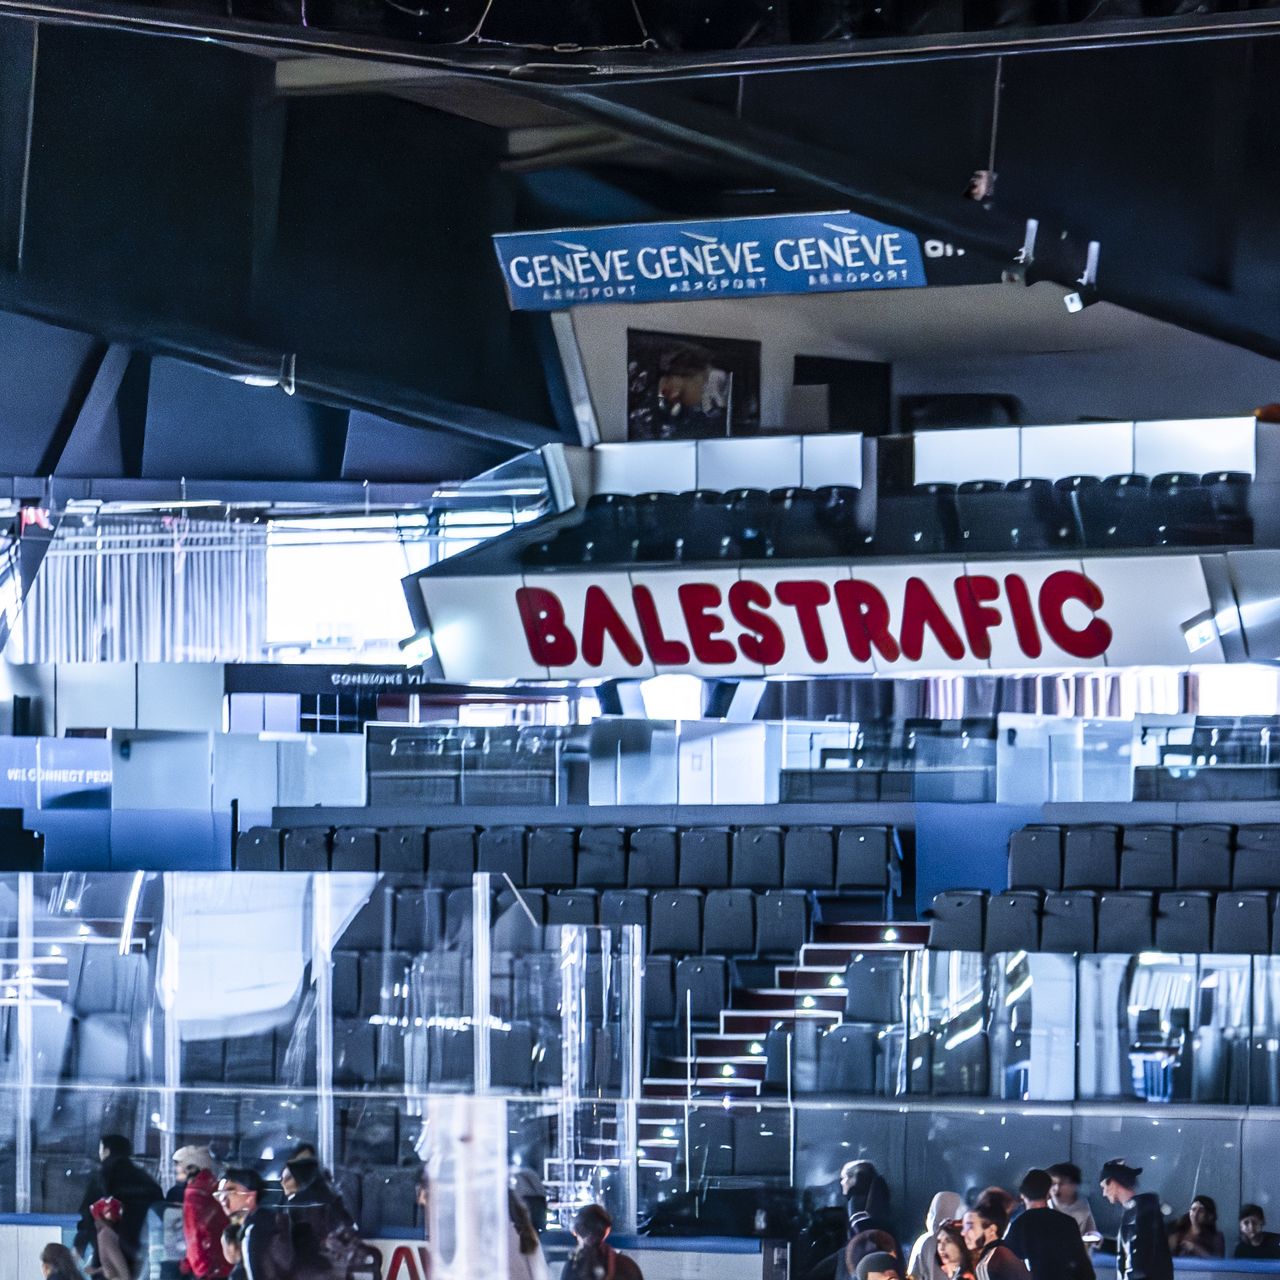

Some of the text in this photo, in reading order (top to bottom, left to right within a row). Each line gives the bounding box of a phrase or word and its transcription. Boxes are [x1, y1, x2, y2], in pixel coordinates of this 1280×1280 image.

[510, 240, 632, 288] GENÈVE
[637, 232, 765, 280] GENÈVE
[774, 223, 908, 272] GENÈVE
[515, 570, 1113, 668] BALESTRAFIC
